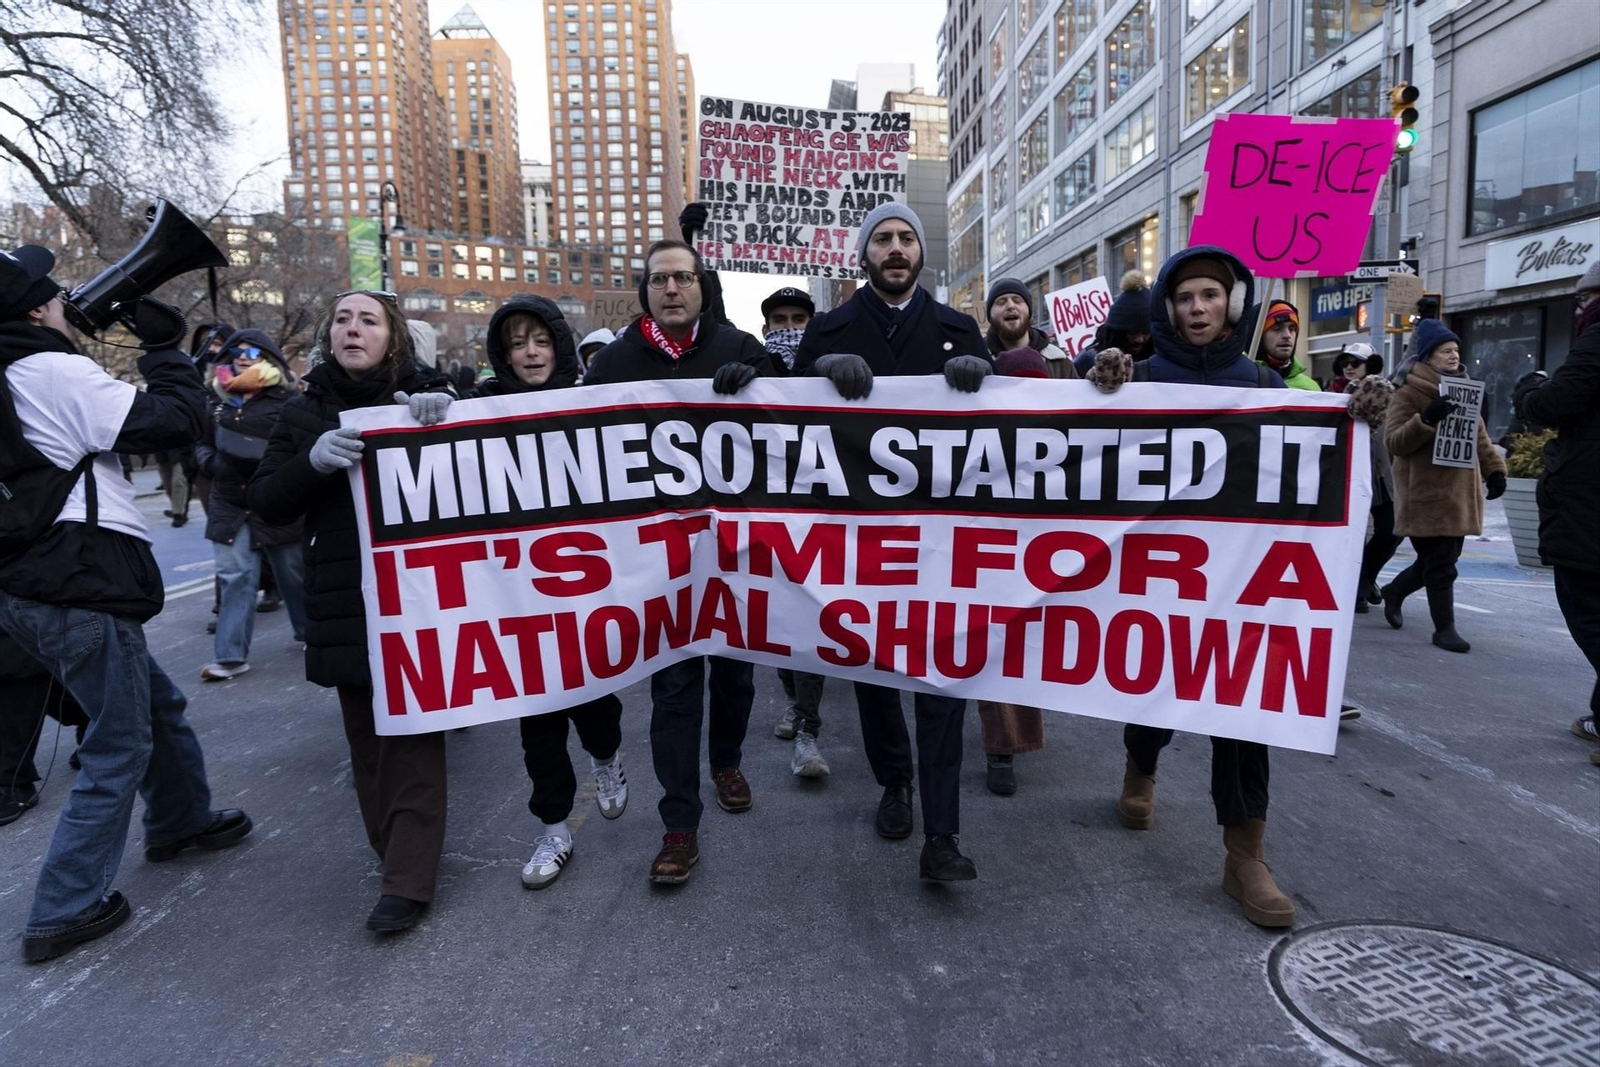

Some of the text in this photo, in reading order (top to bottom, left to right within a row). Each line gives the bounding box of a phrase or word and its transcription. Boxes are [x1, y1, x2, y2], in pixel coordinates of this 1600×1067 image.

[701, 97, 733, 119] ON
[740, 102, 837, 130] AUGUST
[870, 112, 911, 132] 2025
[700, 120, 824, 149] CHAOFENG
[867, 132, 911, 152] WAS
[700, 139, 899, 171] FOUND HANGING
[1230, 138, 1385, 194] DE-ICE
[700, 159, 724, 180] BY
[730, 161, 777, 183] THE
[852, 172, 906, 193] WITH
[700, 180, 739, 202] HIS
[745, 183, 830, 208] HANDS
[756, 203, 836, 226] BOUND
[697, 222, 738, 244] HIS
[812, 228, 849, 250] AT
[1252, 212, 1330, 265] US
[697, 242, 724, 259] ICE
[731, 243, 844, 267] DETENTION
[703, 258, 769, 274] LAIMING
[774, 261, 833, 278] THAT'S
[1359, 267, 1379, 277] ONE
[595, 300, 636, 316] FUCK
[1317, 291, 1342, 314] five
[1065, 334, 1093, 359] IC
[1447, 386, 1480, 406] JUSTICE
[1439, 417, 1475, 441] RENEE
[1436, 438, 1472, 460] GOOD
[376, 420, 1337, 526] MINNESOTA STARTED IT
[372, 516, 1339, 617] IT'S TIME FOR A
[380, 577, 1332, 718] NATIONAL SHUTDOWN
